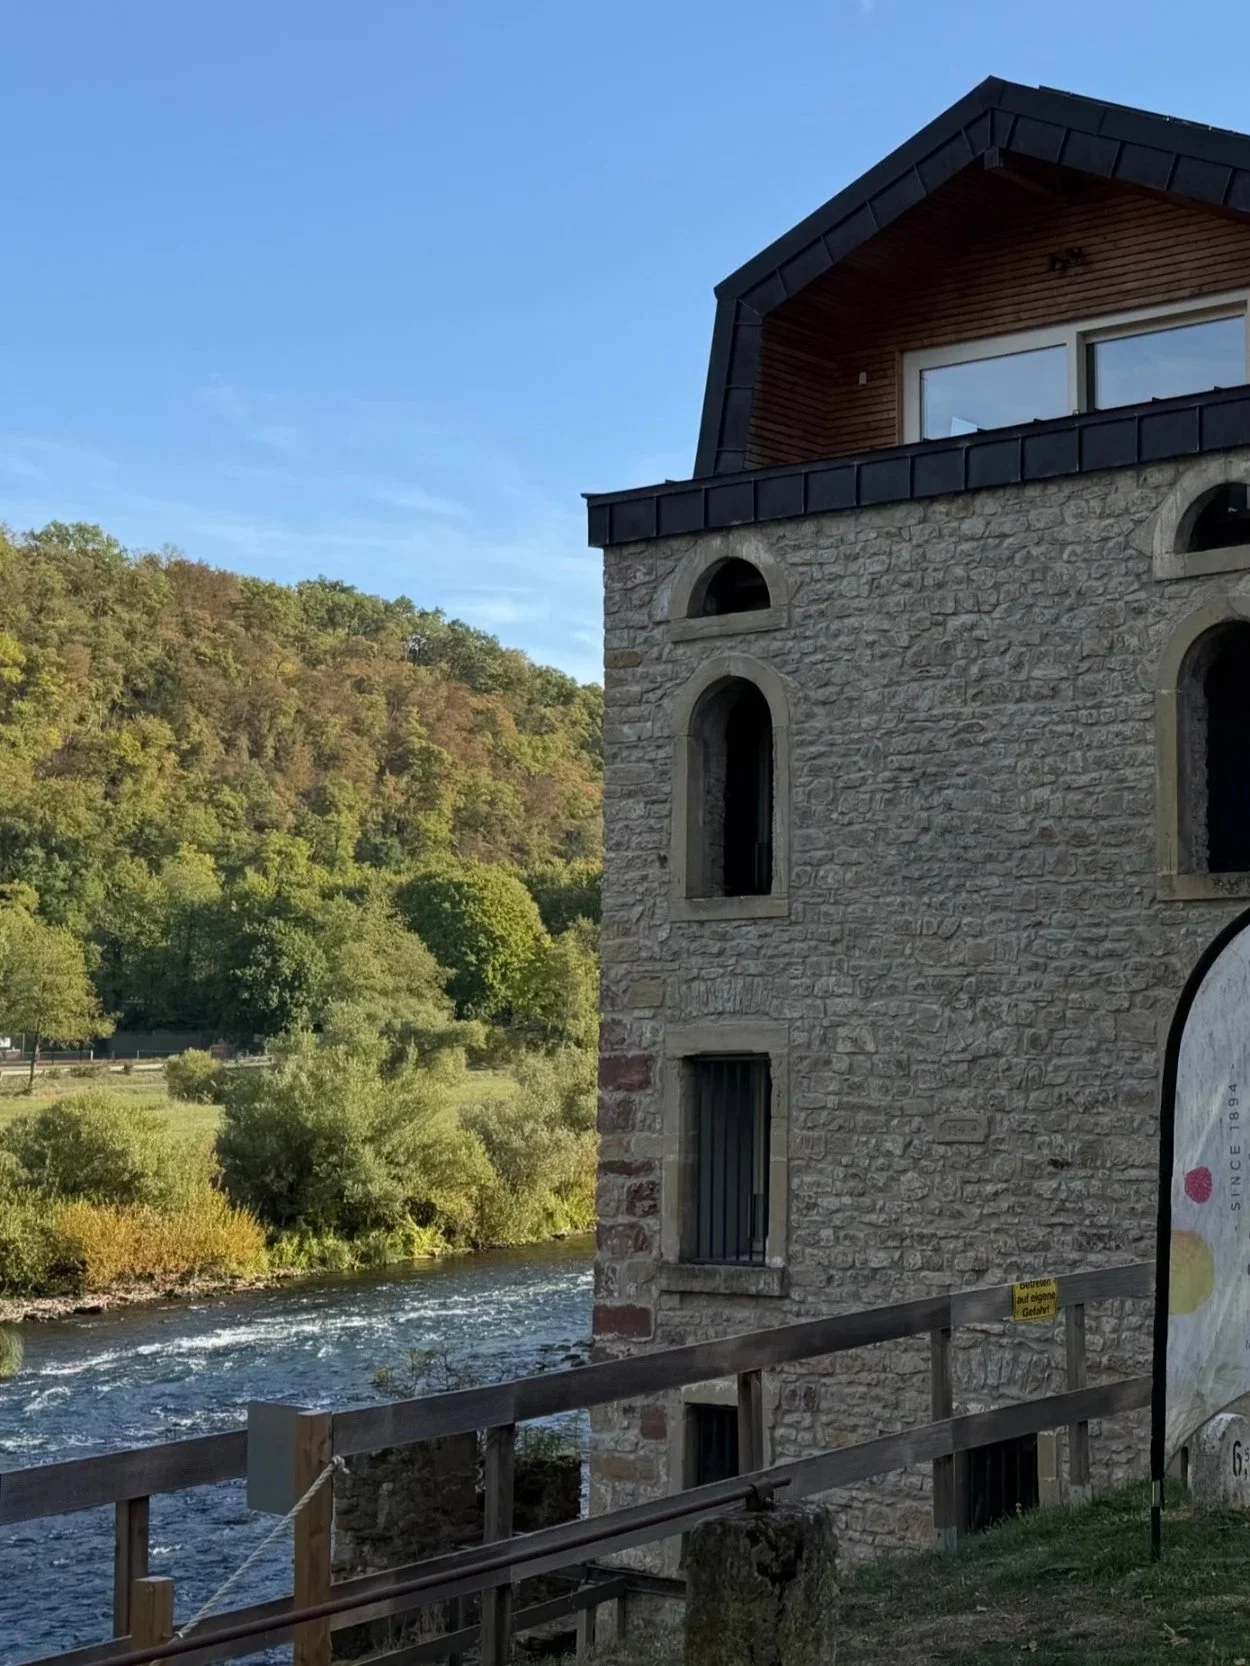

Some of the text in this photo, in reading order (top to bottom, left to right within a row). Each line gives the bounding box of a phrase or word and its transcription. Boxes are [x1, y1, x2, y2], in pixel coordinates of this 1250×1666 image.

[1228, 1083, 1241, 1211] SINCE 1894
[1017, 1292, 1056, 1304] auf eigene
